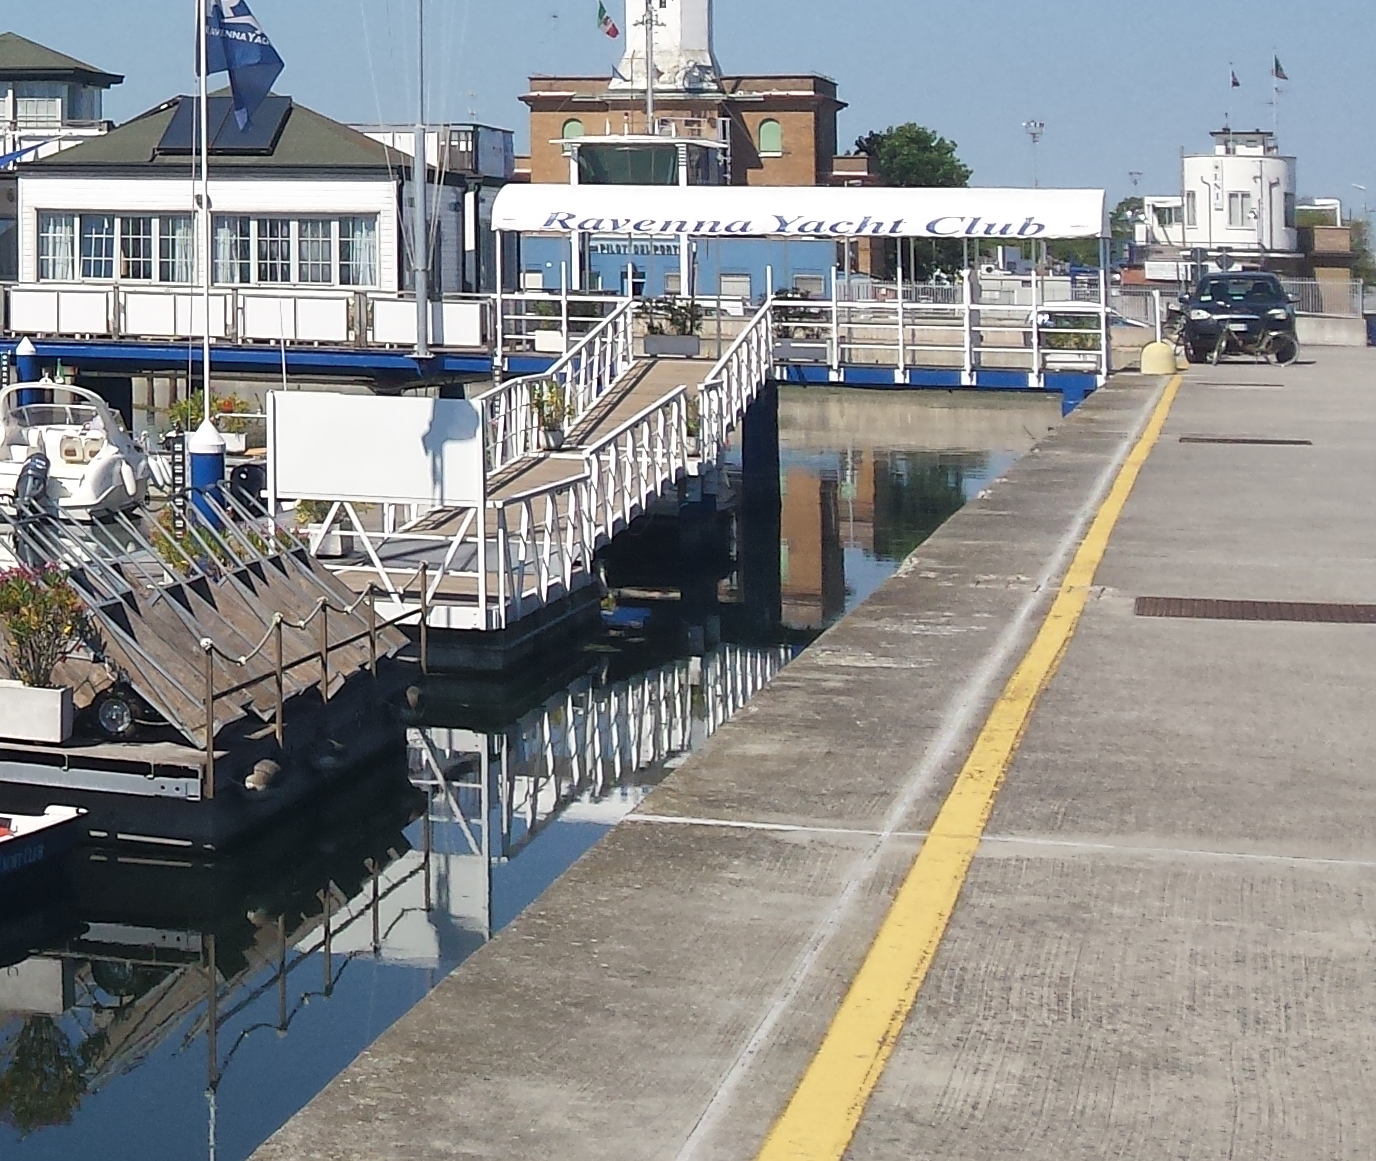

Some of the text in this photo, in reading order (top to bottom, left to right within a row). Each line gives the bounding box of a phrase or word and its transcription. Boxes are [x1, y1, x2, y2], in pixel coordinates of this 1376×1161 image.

[543, 211, 1045, 236] Ravenna Yacht Club
[600, 243, 632, 255] PILOT
[653, 244, 680, 256] PORT
